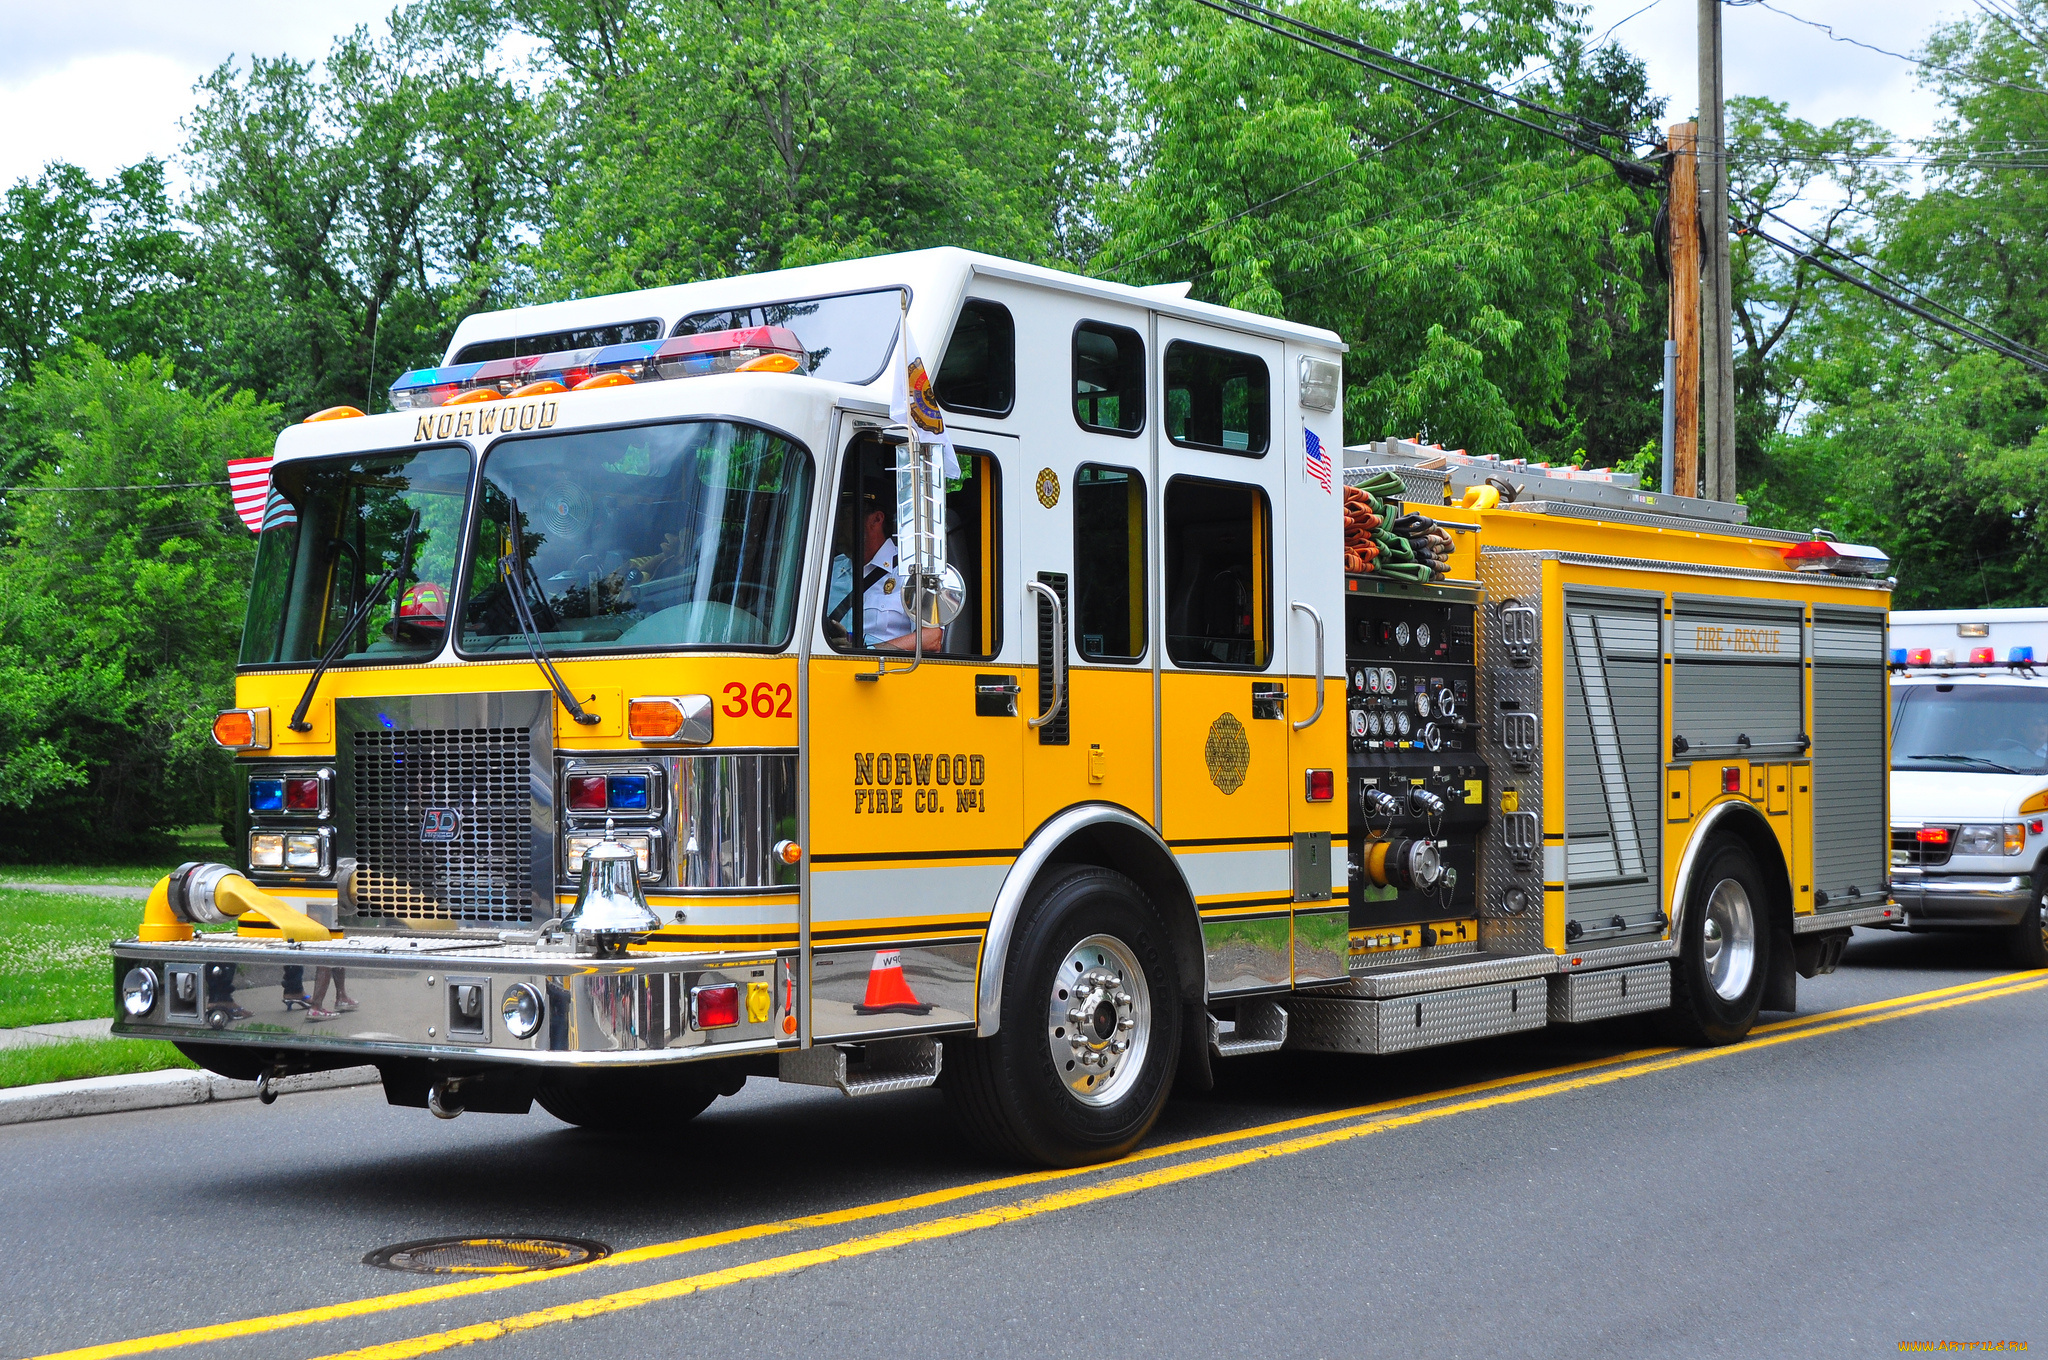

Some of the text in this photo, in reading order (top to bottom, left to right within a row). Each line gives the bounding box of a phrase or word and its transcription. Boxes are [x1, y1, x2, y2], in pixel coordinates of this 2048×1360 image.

[414, 399, 560, 442] NORWOOD
[1695, 626, 1780, 654] FIRE RESCUE
[722, 681, 793, 718] 362
[854, 752, 986, 786] NORWOOD
[854, 788, 903, 814] FIRE
[915, 788, 945, 814] CO.
